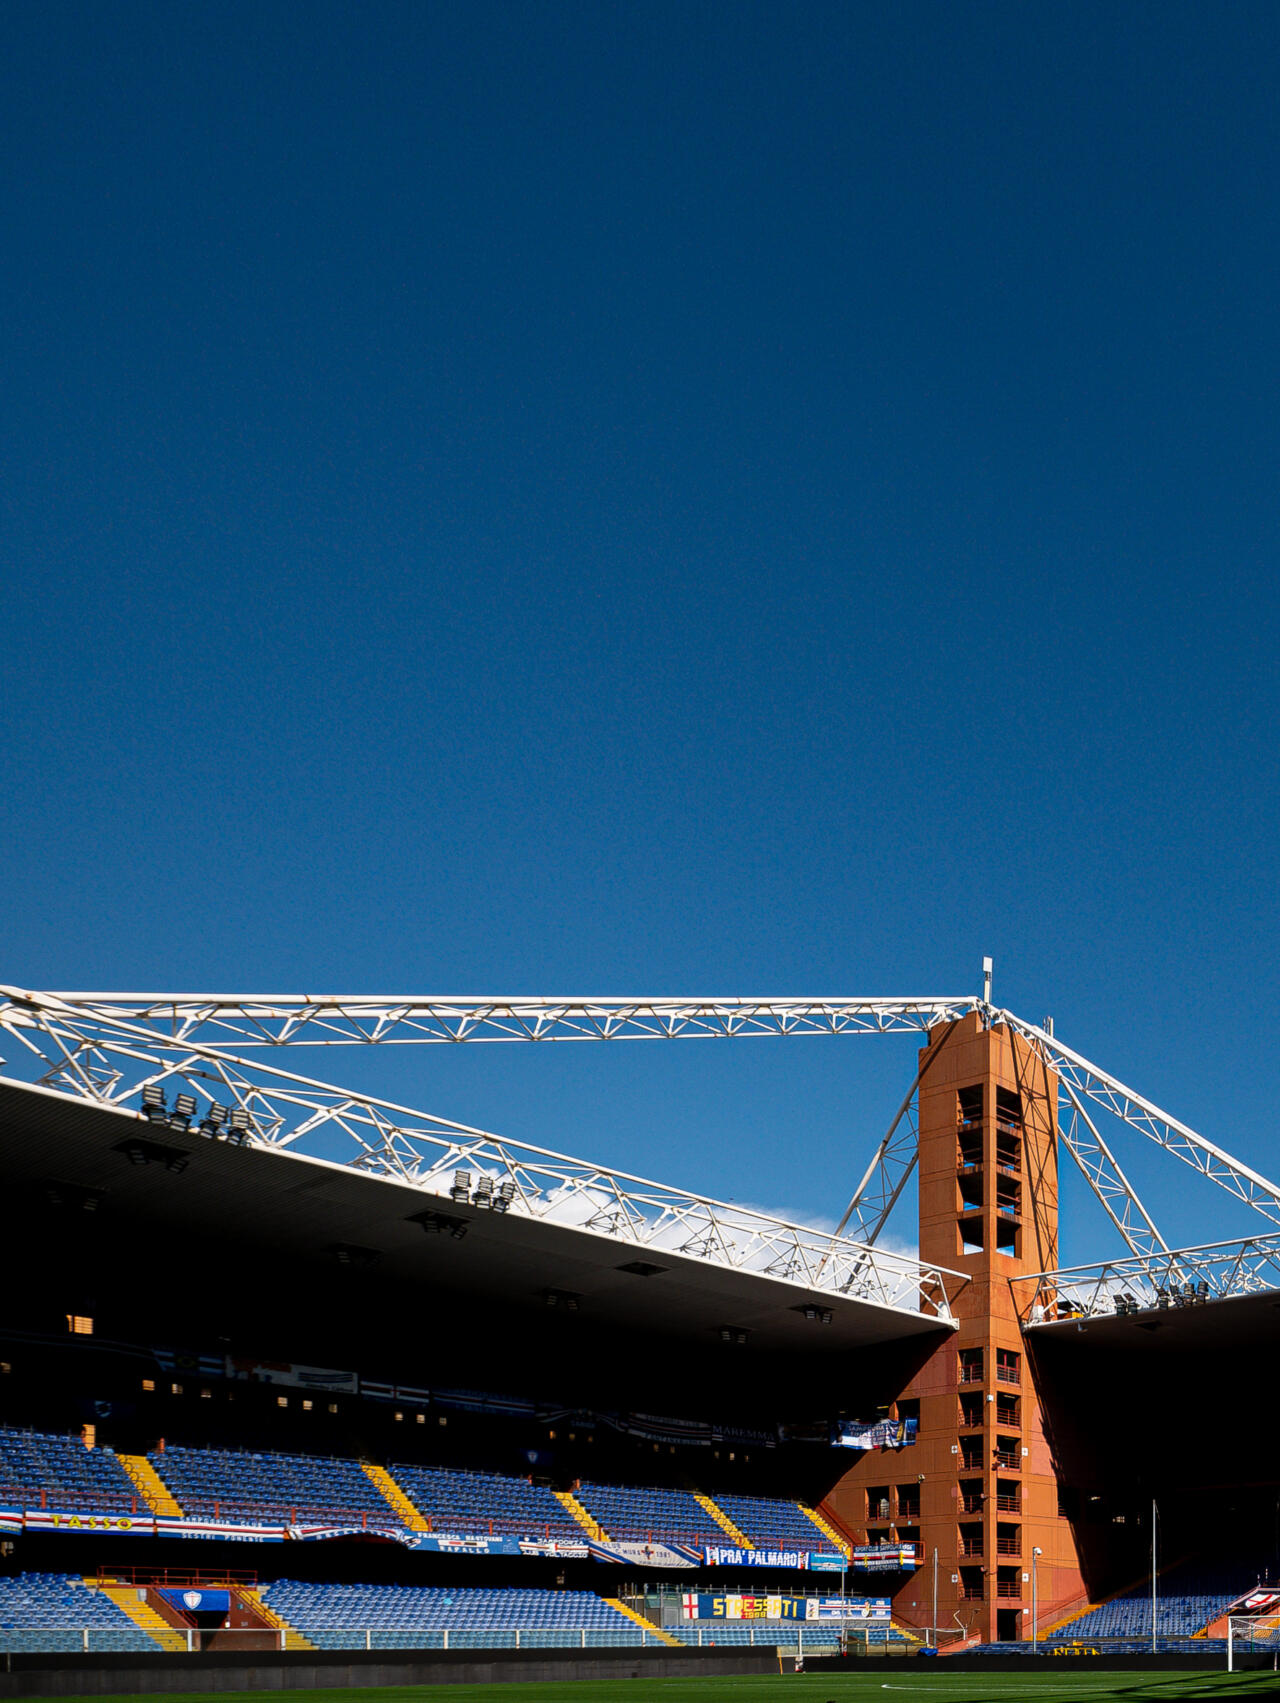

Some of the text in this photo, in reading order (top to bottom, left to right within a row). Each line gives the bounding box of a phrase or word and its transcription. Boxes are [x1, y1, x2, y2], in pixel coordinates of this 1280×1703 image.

[712, 1424, 775, 1442] MAREMMA
[50, 1514, 133, 1530] TASSO
[417, 1532, 461, 1540] FRANCESCA
[439, 1546, 490, 1554] RAPALLO
[748, 1550, 798, 1567] PALMARO
[713, 1598, 798, 1617] STRESSATI
